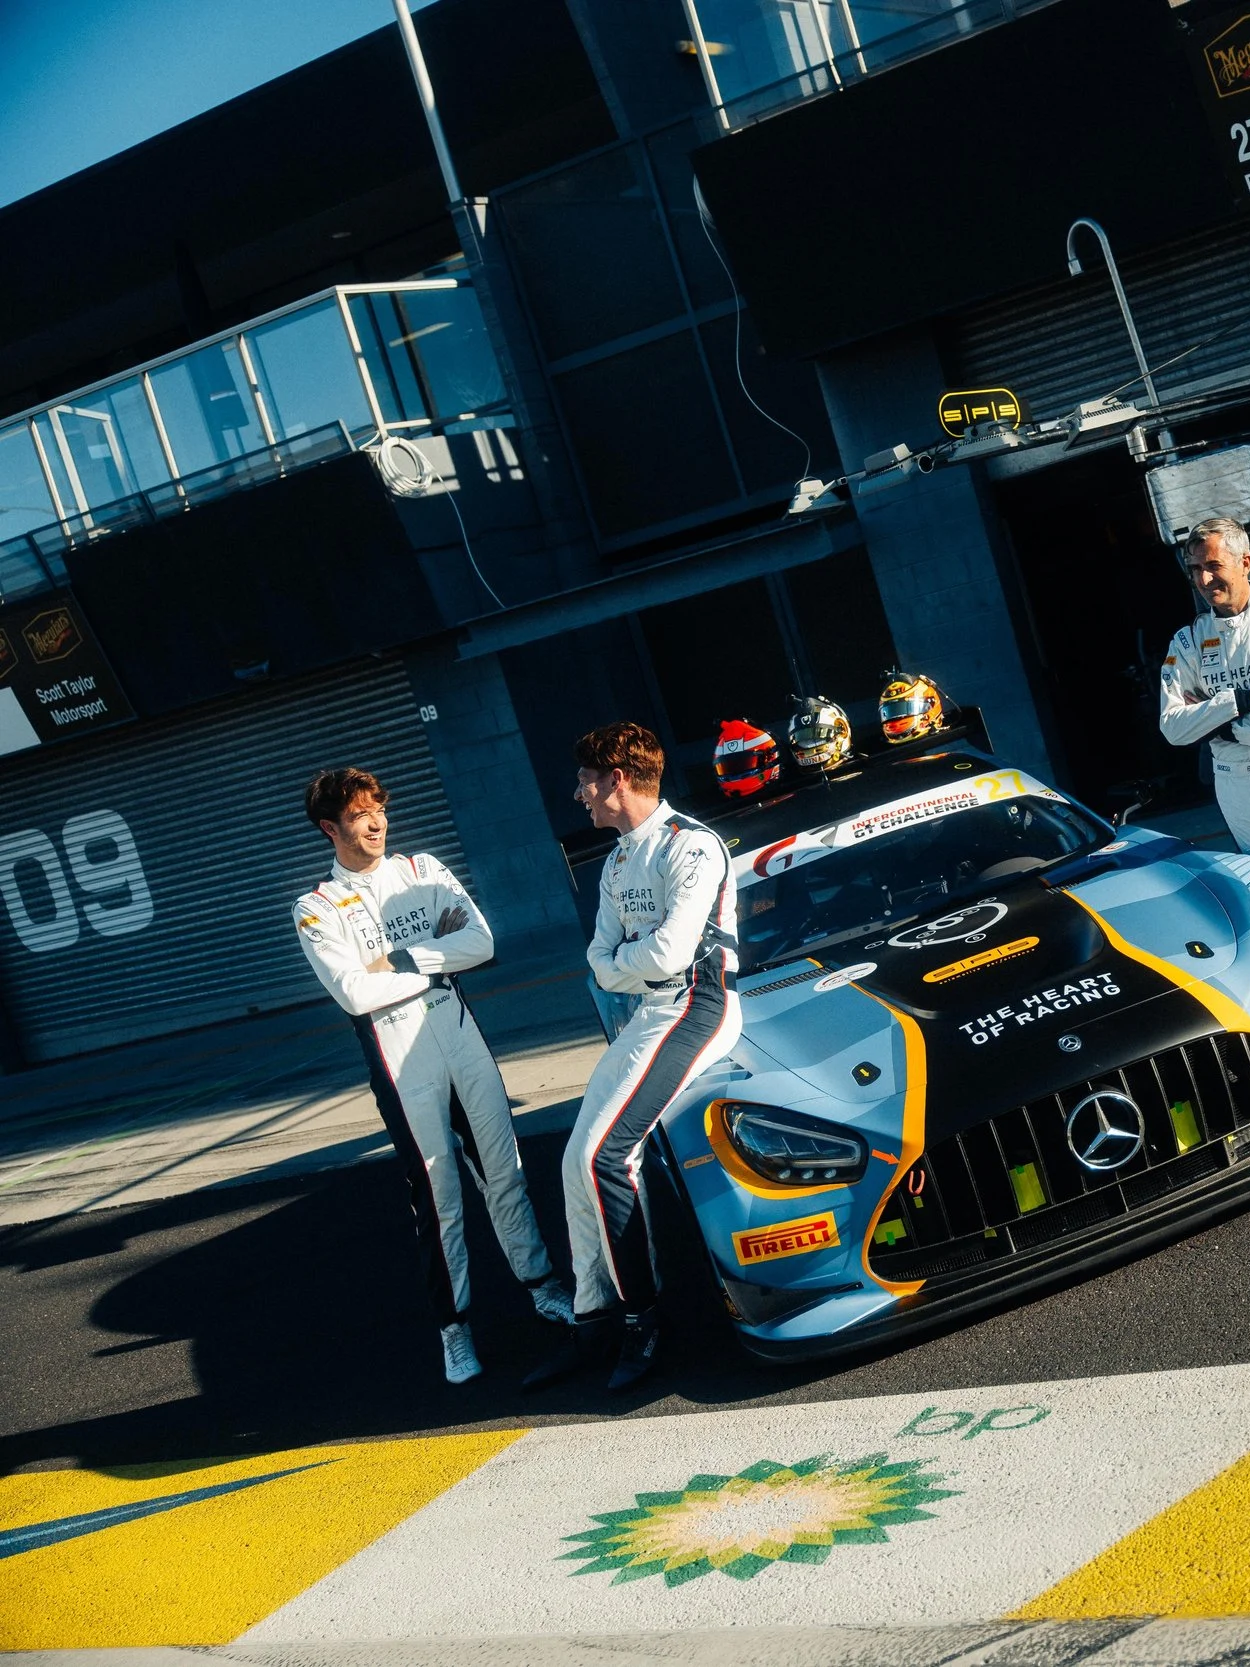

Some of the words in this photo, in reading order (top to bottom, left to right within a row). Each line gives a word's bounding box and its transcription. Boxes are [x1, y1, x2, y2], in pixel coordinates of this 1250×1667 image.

[35, 683, 65, 704] Scott
[61, 675, 97, 697] Taylor
[1203, 671, 1227, 685] THE
[50, 697, 108, 726] Motorsport
[420, 704, 438, 722] 09
[974, 770, 1027, 800] 27
[851, 791, 977, 831] INTERCONTINENTAL
[854, 823, 876, 839] GT
[880, 797, 980, 830] CHALLENGE
[0, 809, 154, 953] 09
[622, 888, 653, 901] HEART
[386, 906, 427, 931] HEART
[386, 920, 431, 943] RACING
[958, 1005, 1016, 1035] THE
[1022, 972, 1112, 1009] HEART
[971, 1022, 1005, 1045] OF
[1015, 984, 1121, 1026] RACING
[739, 1220, 831, 1259] PIRELLI
[894, 1403, 1052, 1440] bp
